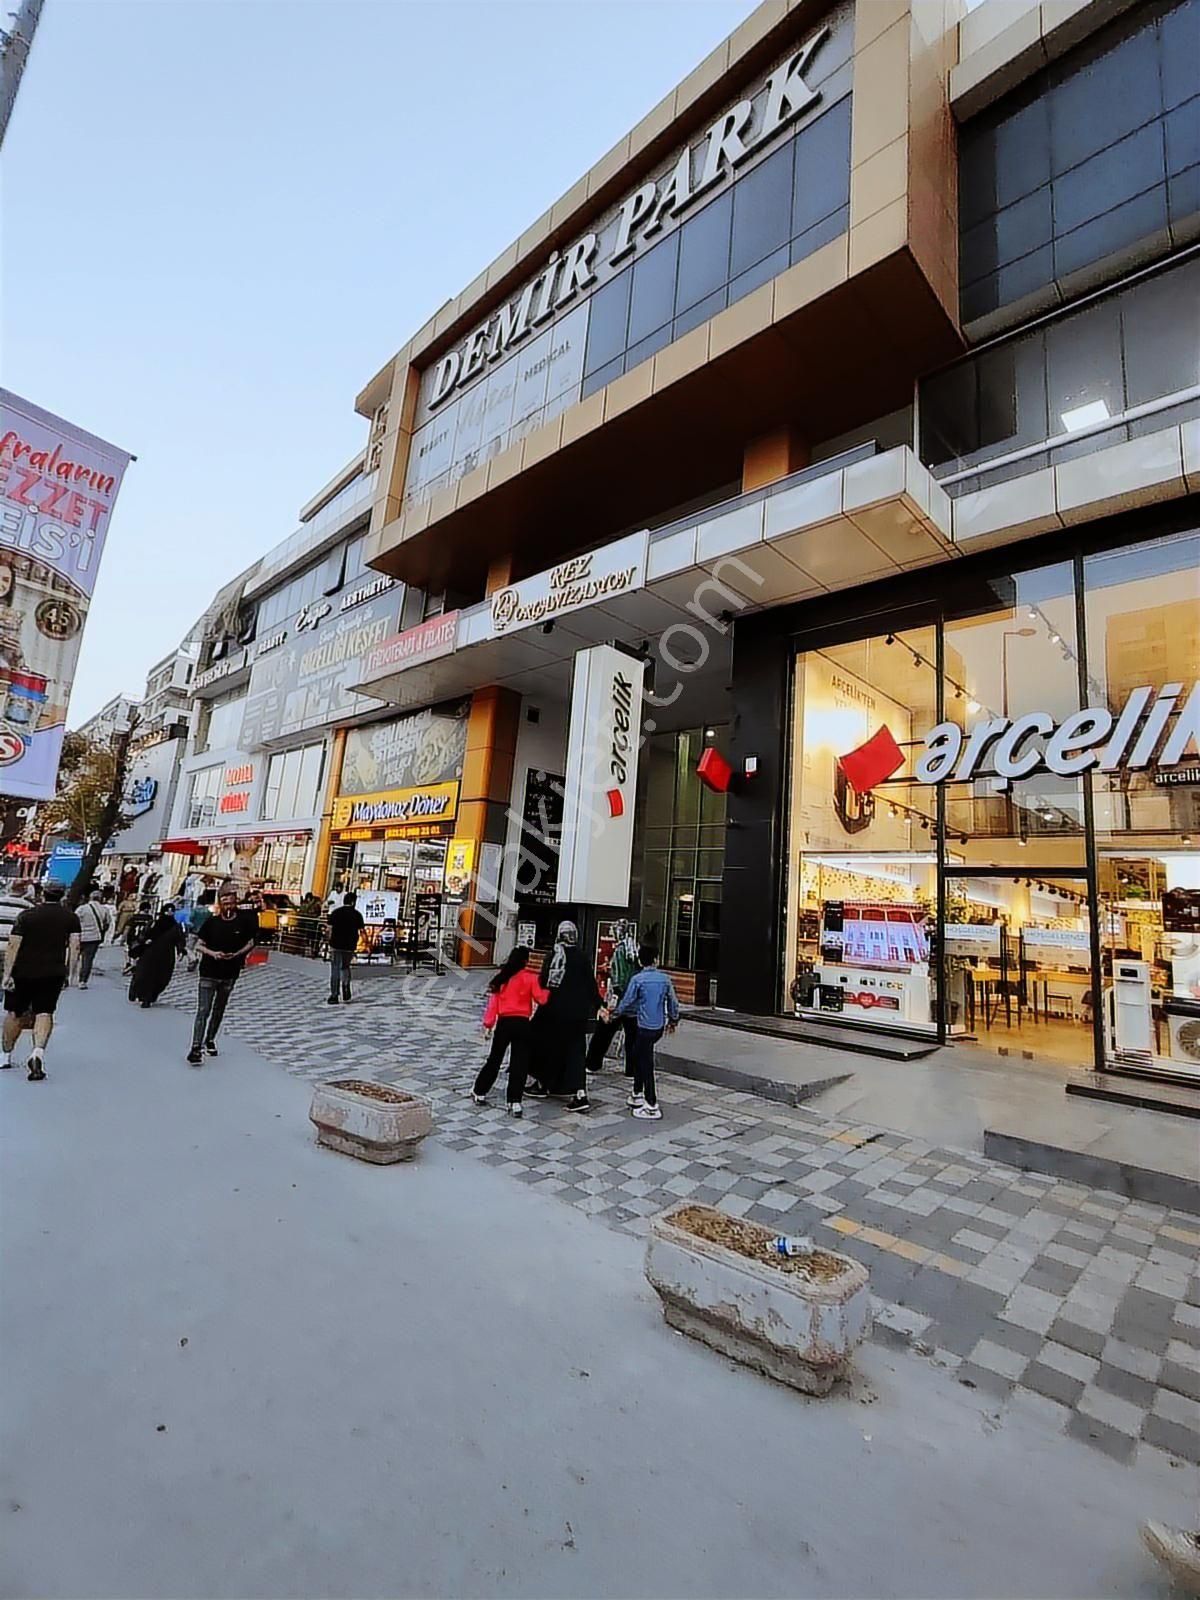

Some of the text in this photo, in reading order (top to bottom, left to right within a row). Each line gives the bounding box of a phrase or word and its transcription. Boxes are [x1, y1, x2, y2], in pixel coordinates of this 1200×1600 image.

[428, 25, 830, 411] DEMİR PARK
[524, 340, 572, 382] MEDICAL
[406, 794, 451, 818] Döner
